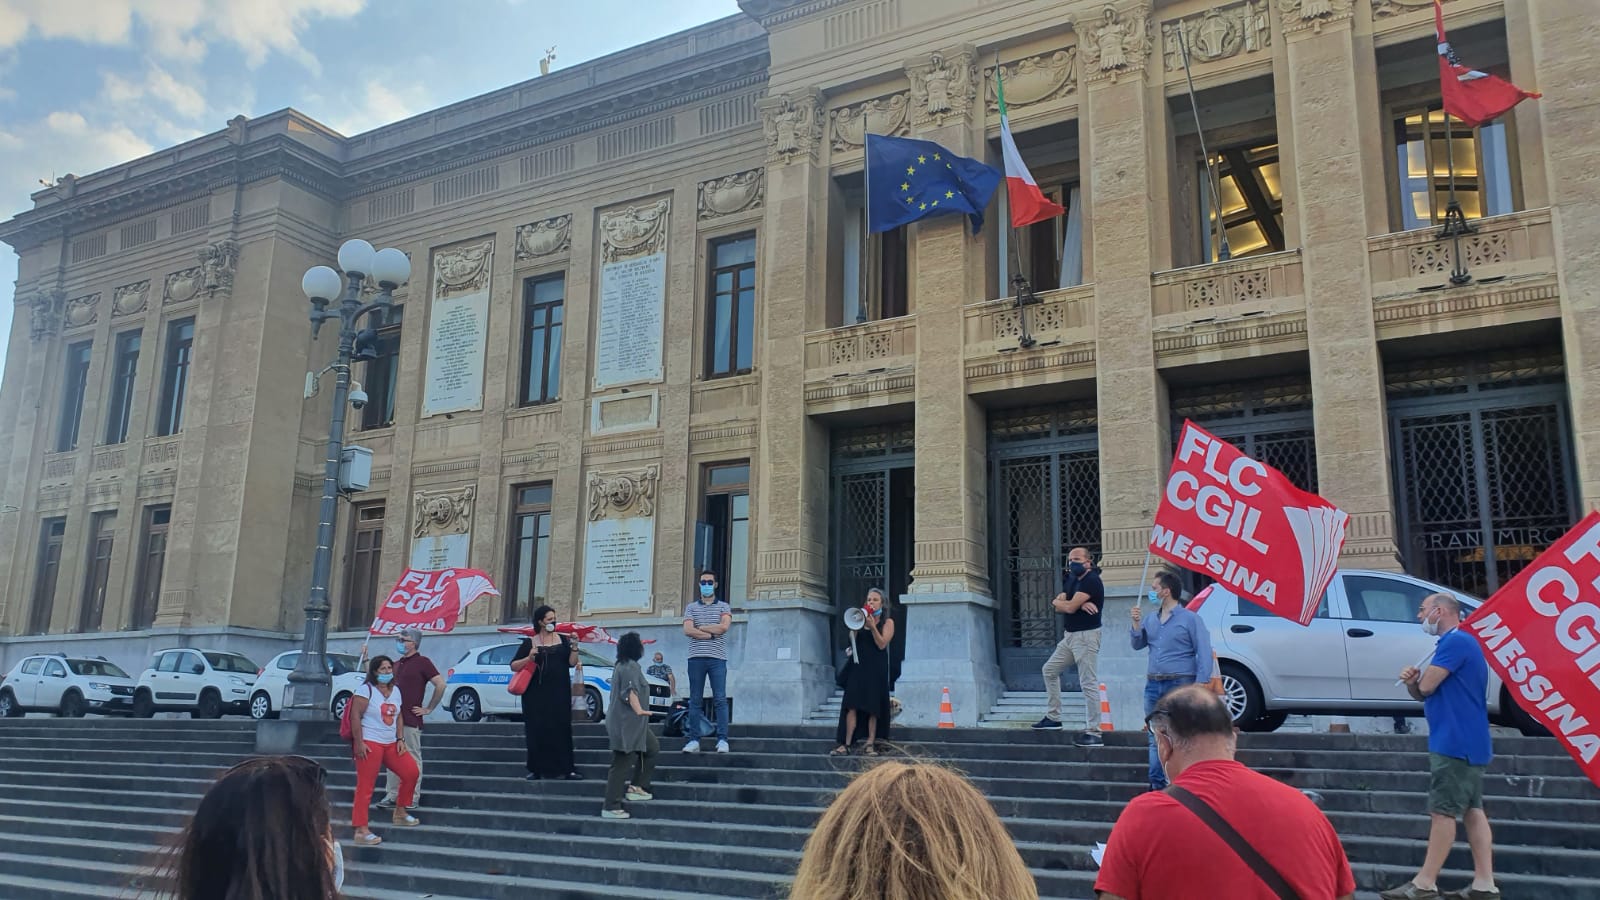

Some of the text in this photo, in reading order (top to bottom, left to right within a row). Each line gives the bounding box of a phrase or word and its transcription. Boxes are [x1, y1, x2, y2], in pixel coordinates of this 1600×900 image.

[1179, 425, 1268, 496] FLC
[1167, 480, 1269, 555] CGIL
[1413, 532, 1480, 550] GRAN
[399, 570, 455, 593] FLC
[1151, 524, 1277, 615] MESSINA
[1471, 612, 1600, 764] MESSINA
